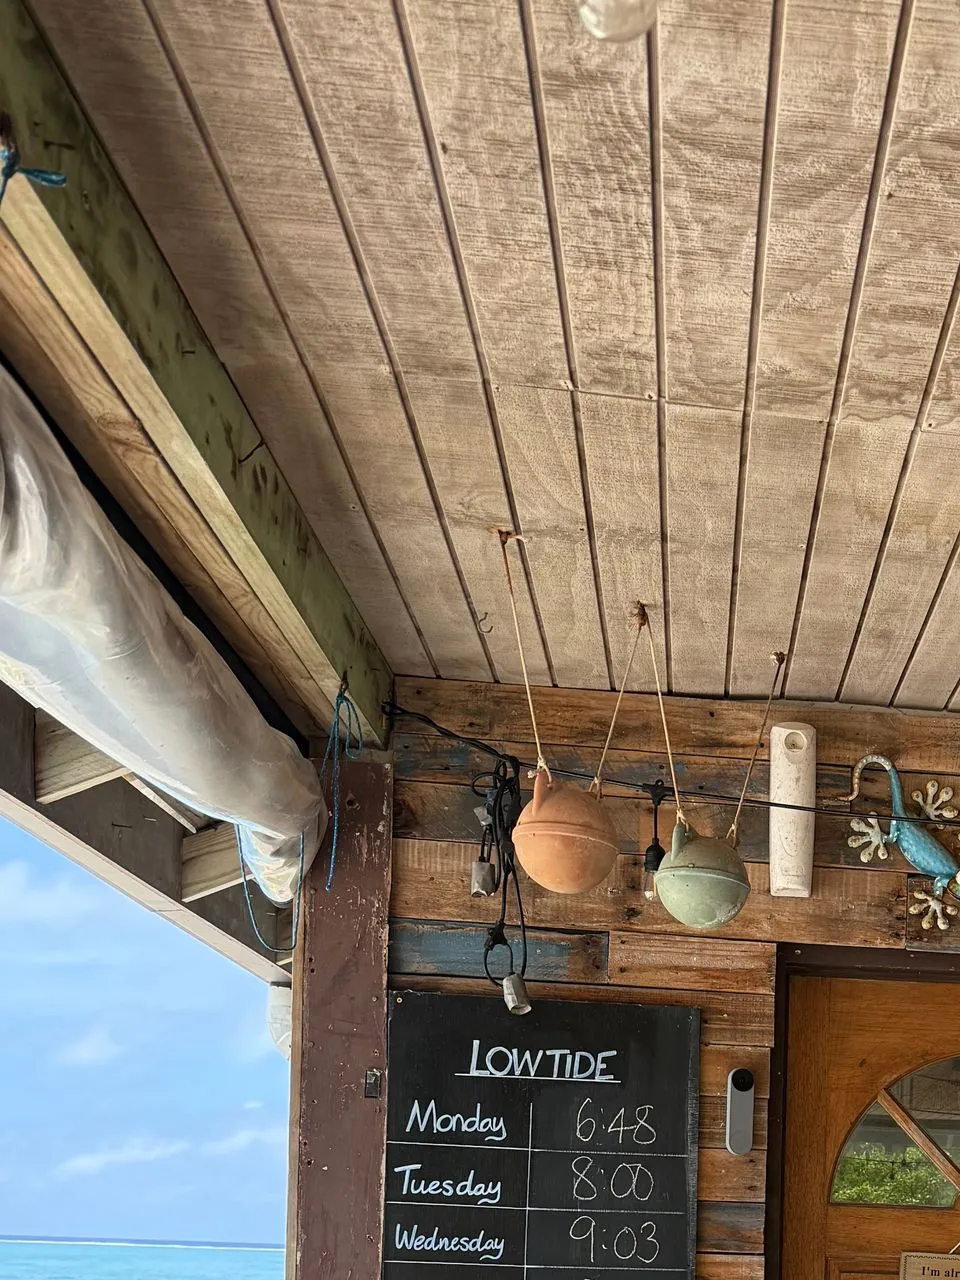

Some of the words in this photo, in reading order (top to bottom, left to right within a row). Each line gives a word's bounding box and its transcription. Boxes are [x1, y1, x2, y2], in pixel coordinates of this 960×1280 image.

[469, 1039, 542, 1077] LOW
[545, 1049, 618, 1081] TIDE
[405, 1099, 508, 1141] Monday
[575, 1098, 657, 1145] 6:48
[394, 1164, 501, 1205] Tuesday
[571, 1156, 655, 1201] 8:00
[394, 1223, 505, 1261] Wednesday
[569, 1215, 660, 1263] 9:03
[921, 1266, 940, 1278] I'm
